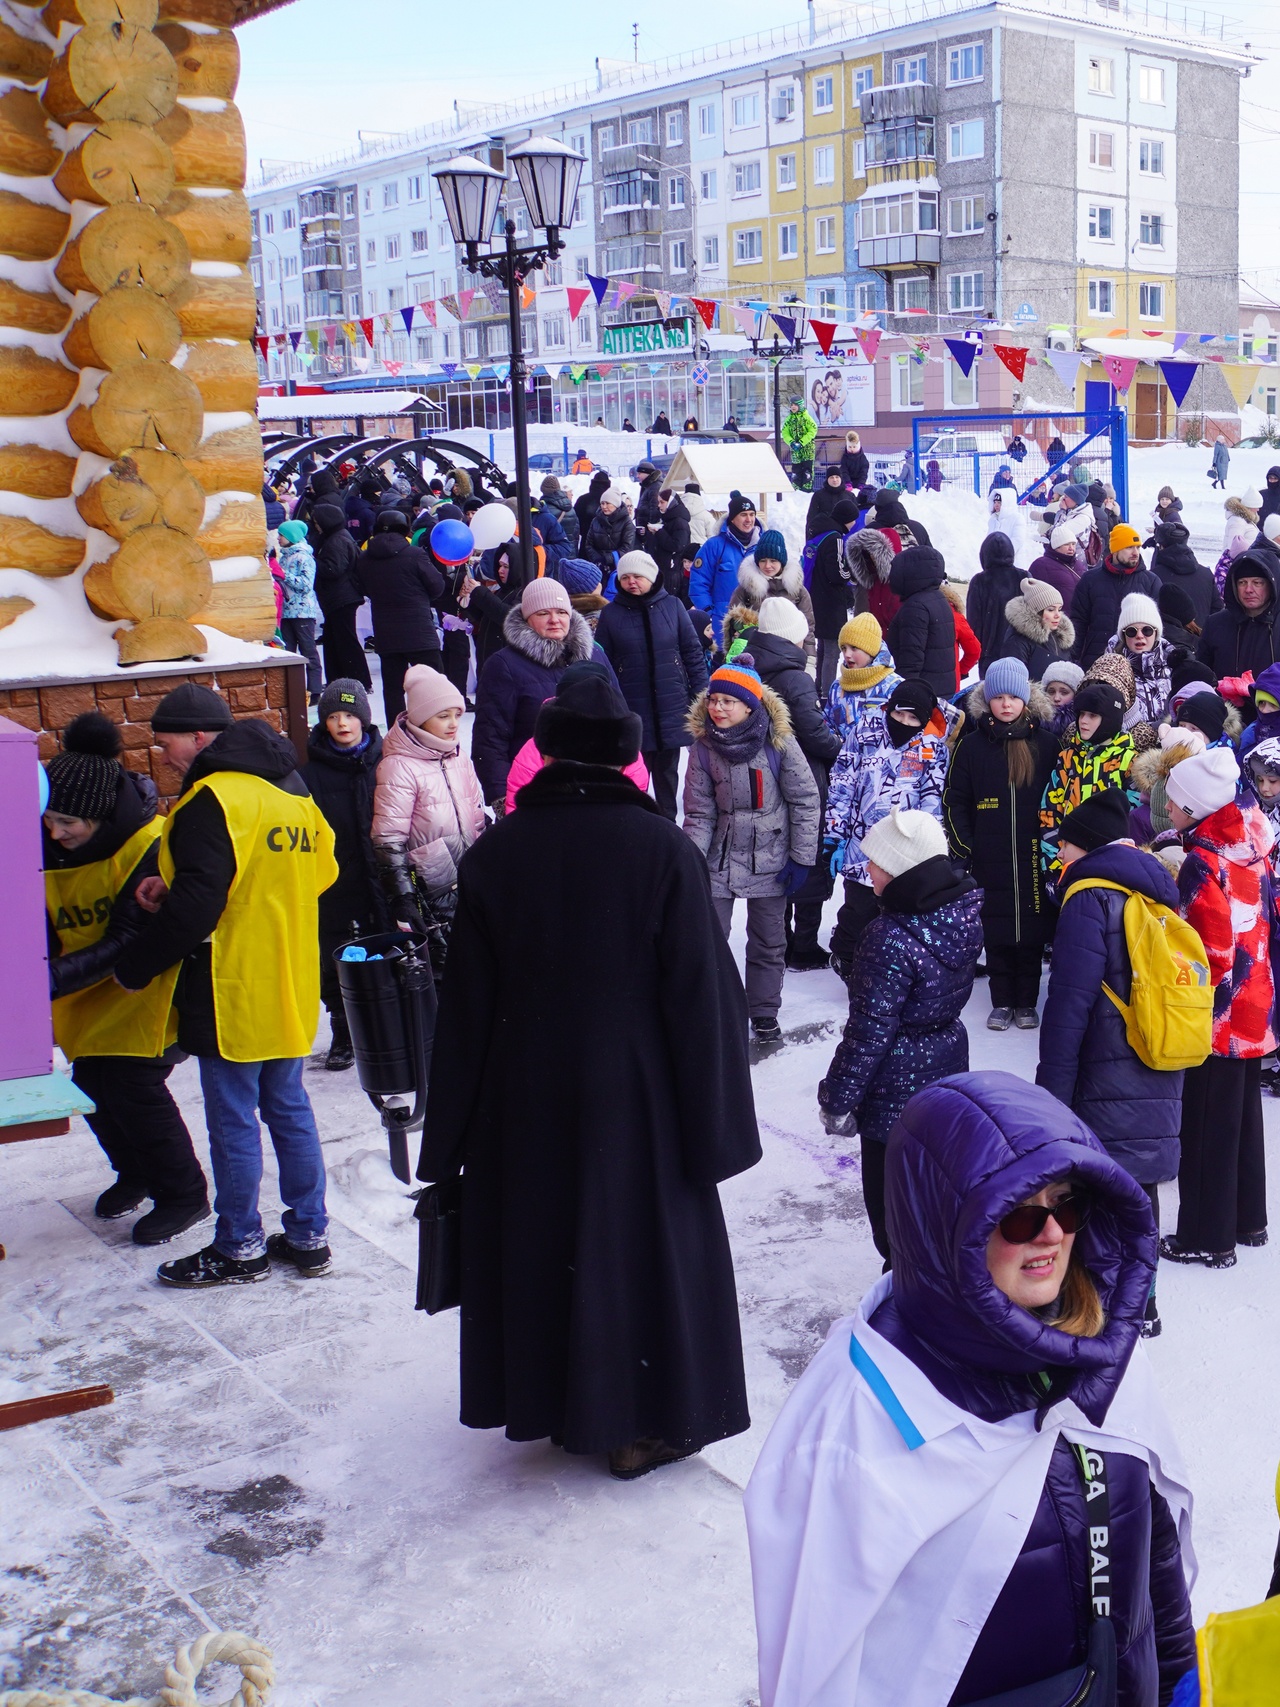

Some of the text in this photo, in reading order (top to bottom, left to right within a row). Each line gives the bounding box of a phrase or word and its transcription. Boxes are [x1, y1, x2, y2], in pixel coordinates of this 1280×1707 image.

[603, 323, 665, 354] АПТЕКА
[266, 826, 320, 853] СУД
[56, 896, 114, 931] ДЬЯ
[1086, 1451, 1106, 1503] GA
[1090, 1526, 1111, 1617] BALE
